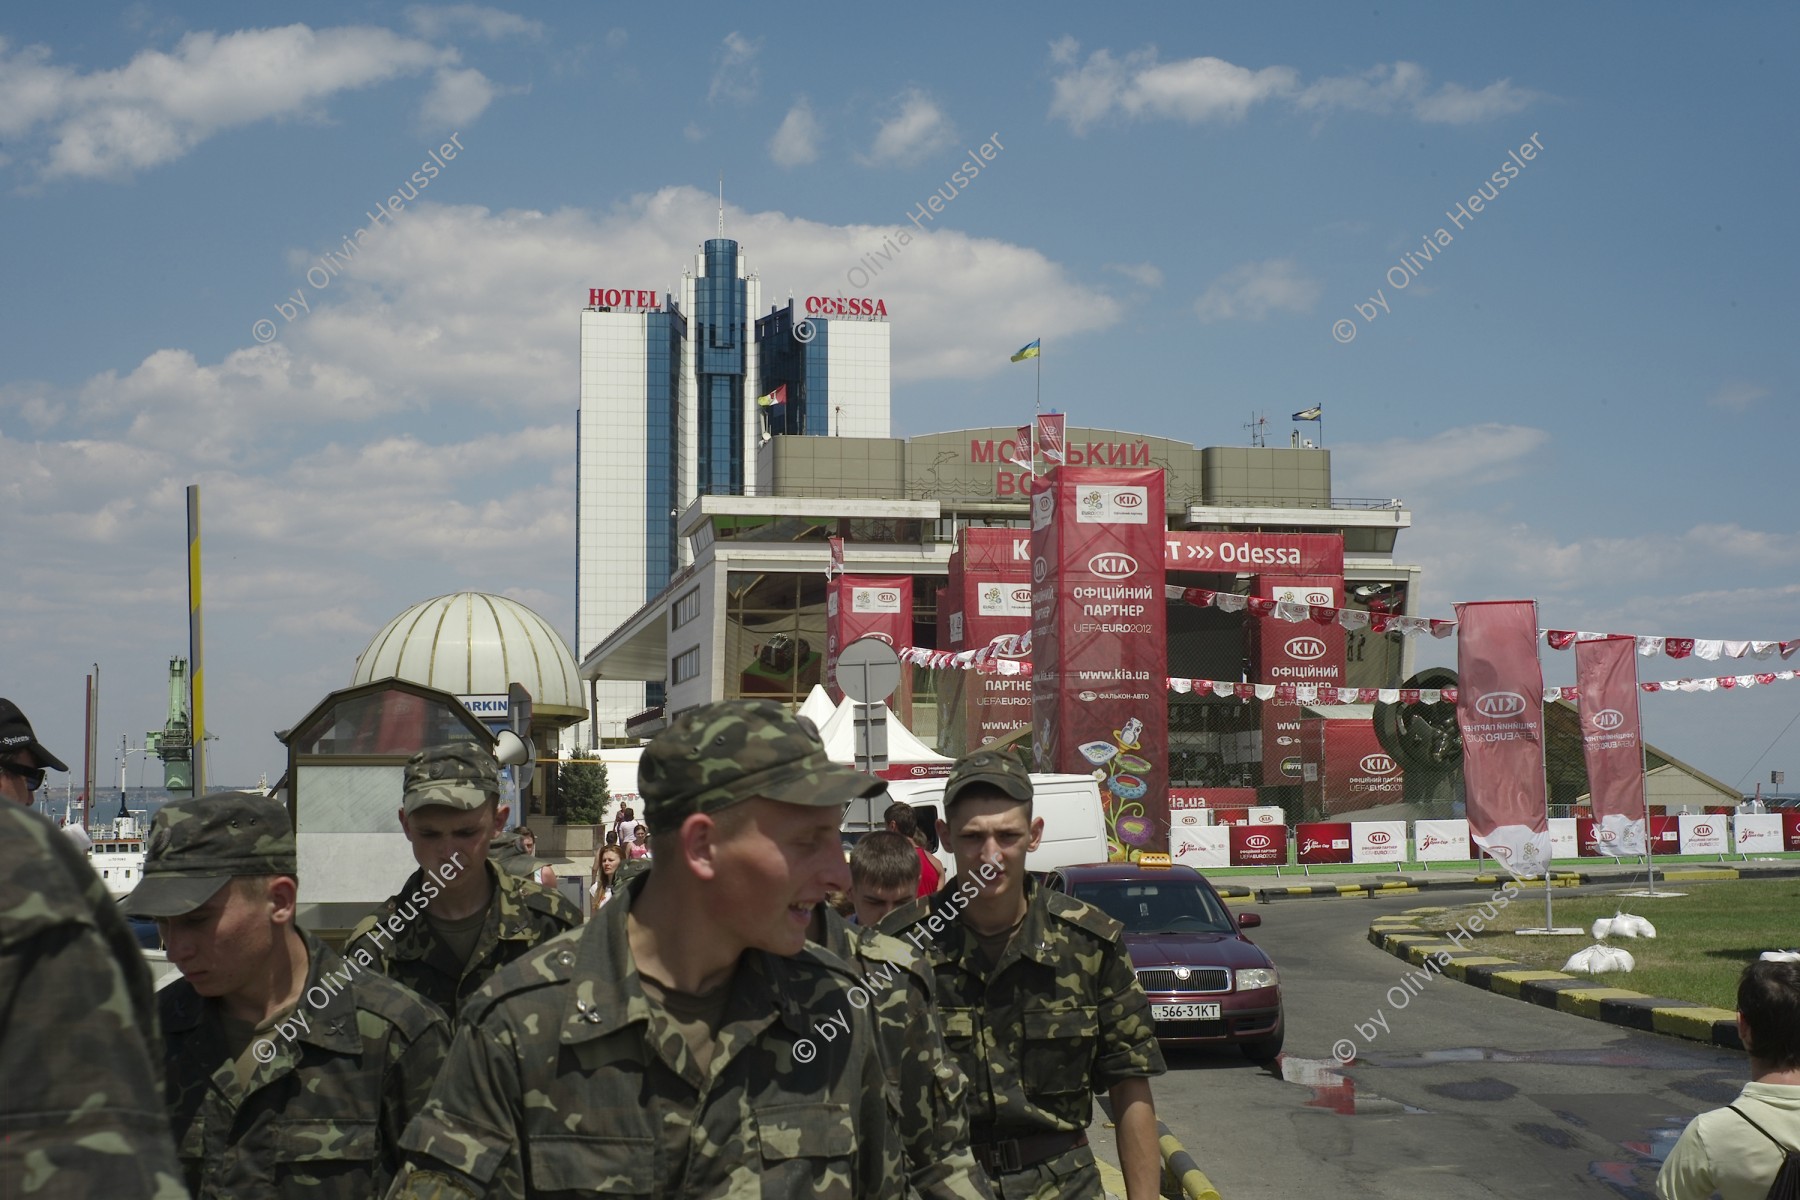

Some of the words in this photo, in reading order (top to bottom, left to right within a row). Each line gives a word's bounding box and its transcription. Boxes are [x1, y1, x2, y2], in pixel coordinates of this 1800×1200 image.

[589, 288, 661, 308] HOTEL
[805, 296, 888, 317] ODESSA
[1165, 541, 1181, 560] T
[1219, 542, 1301, 564] Odessa
[1098, 559, 1130, 572] KIA
[1073, 585, 1152, 600] ОФІЦІЙНИЙ
[1083, 604, 1144, 616] ПАРТНЕР
[1293, 643, 1319, 655] KIA
[1079, 669, 1149, 680] www.kia.ua
[1272, 665, 1338, 678] ОФІЦІЙНИЙ
[1367, 759, 1390, 769] KIA
[1162, 1005, 1217, 1017] 566-31KT
